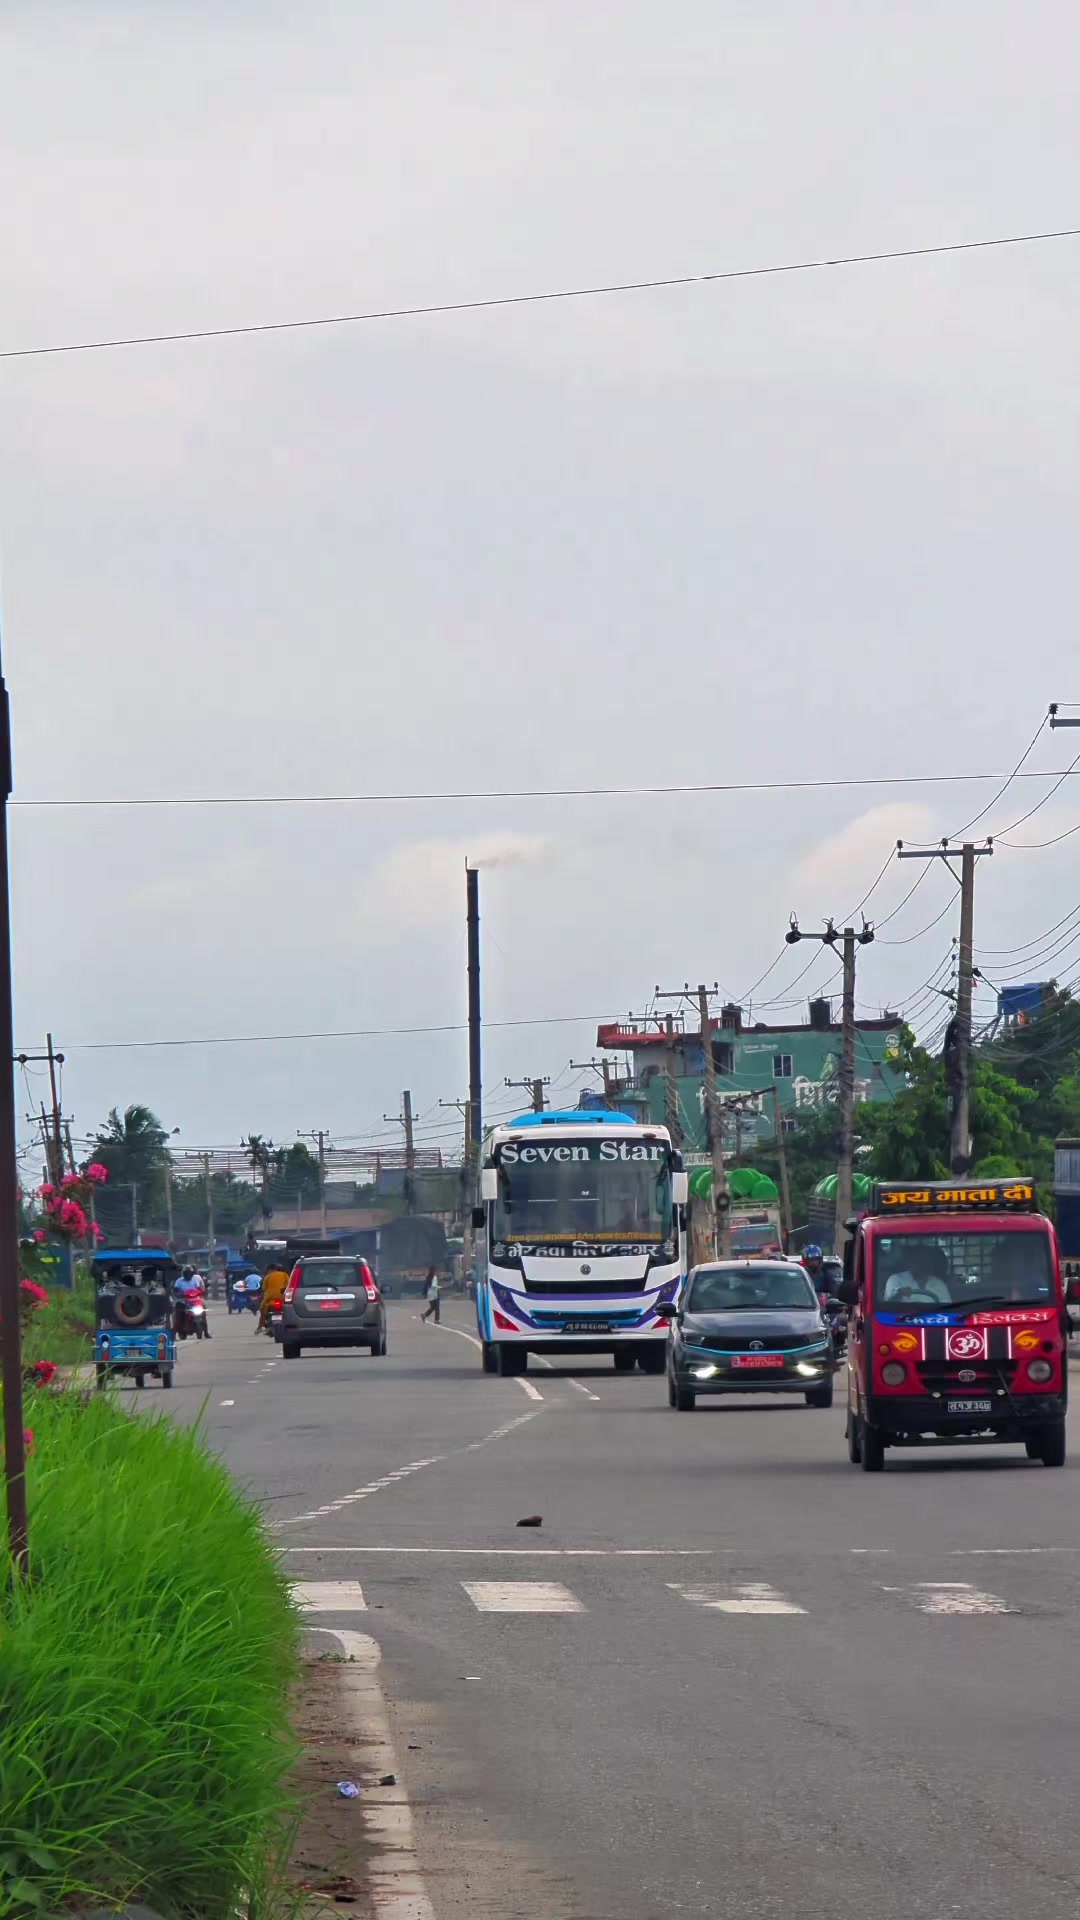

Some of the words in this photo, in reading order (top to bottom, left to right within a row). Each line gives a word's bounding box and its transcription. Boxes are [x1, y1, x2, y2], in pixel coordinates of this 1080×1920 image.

[500, 1143, 590, 1163] Seven
[599, 1141, 665, 1161] Star
[881, 1191, 931, 1204] जय
[935, 1188, 998, 1202] माता
[1000, 1184, 1034, 1200] दी
